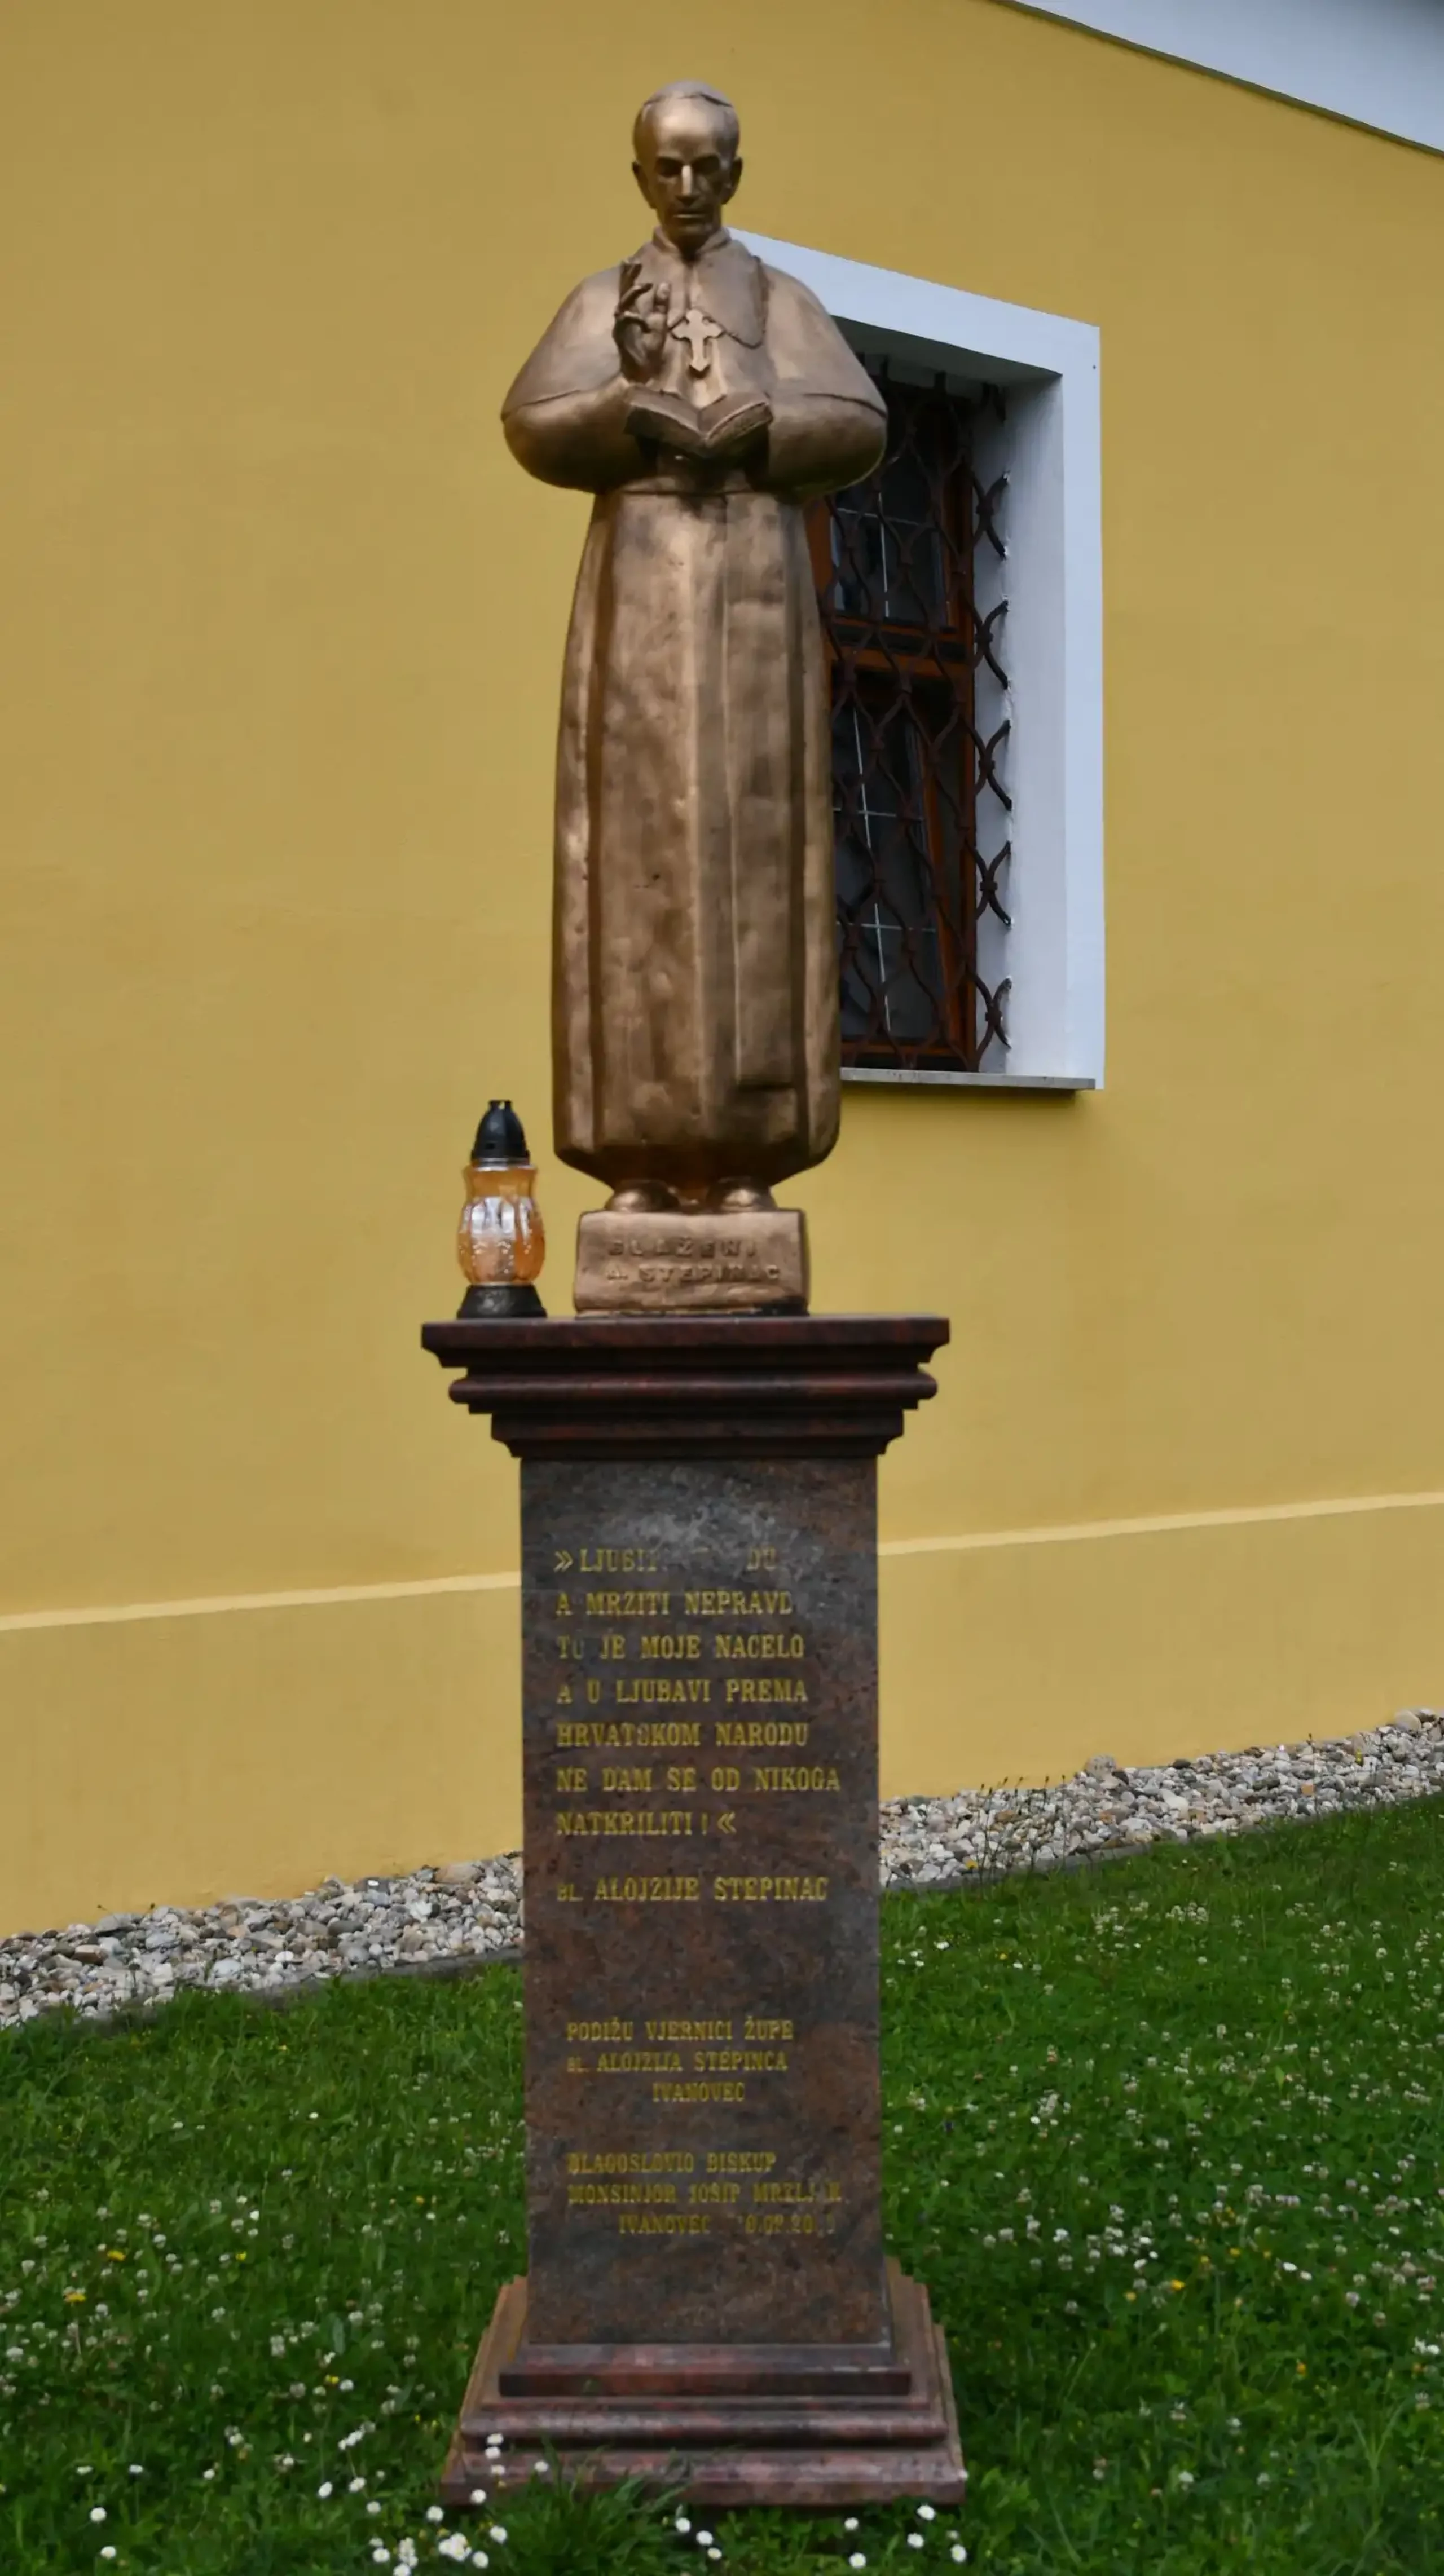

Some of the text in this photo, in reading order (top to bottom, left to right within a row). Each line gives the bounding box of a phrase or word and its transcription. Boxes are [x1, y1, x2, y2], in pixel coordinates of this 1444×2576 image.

[556, 1593, 573, 1615] A
[585, 1591, 670, 1616] MRZITI
[599, 1635, 626, 1659] JE
[641, 1635, 701, 1659] MOJE
[556, 1678, 809, 1704] A U LJUBAVI PREMA
[556, 1721, 809, 1747] HRVATSKOM NARODU
[556, 1766, 841, 1792] NE DAM SE OD NIKOGA
[594, 1877, 699, 1902] ALOJZIJE
[714, 1876, 829, 1901] STEPINAC
[566, 2015, 794, 2042] PODIŽU VJERNICI ŽUPE
[596, 2052, 684, 2072] ALOJZIJA
[694, 2050, 789, 2071] STEPINCA
[653, 2082, 745, 2102] IVANOVEC
[567, 2152, 776, 2174] BLAGOSLOVIO BISKUP
[619, 2214, 711, 2234] IVANOVEC
